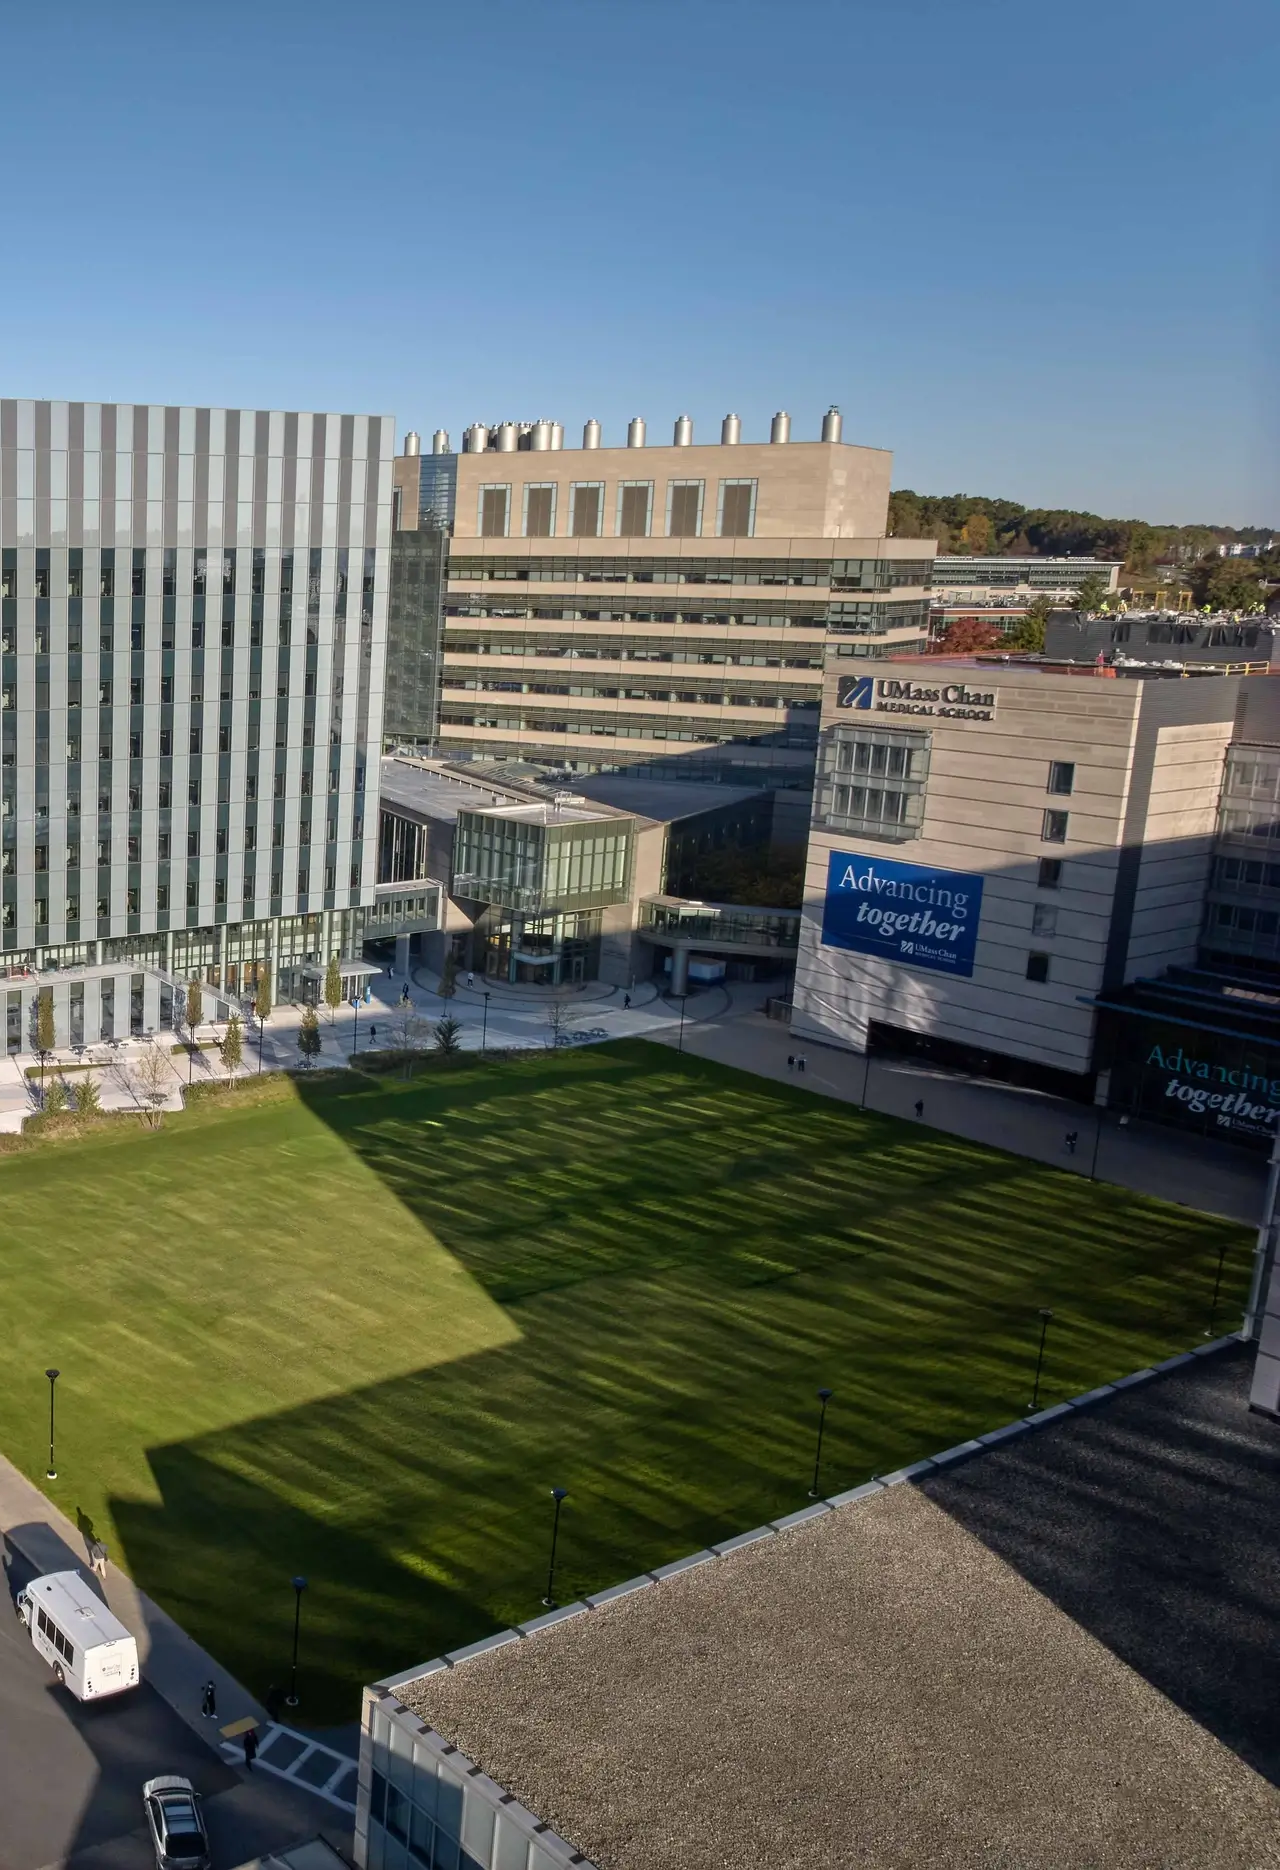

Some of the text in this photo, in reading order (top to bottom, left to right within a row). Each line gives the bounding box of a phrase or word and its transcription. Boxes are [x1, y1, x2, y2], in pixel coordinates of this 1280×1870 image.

[876, 701, 994, 721] MEDICAL SCHOOL
[877, 679, 995, 706] UMass Chan
[839, 864, 969, 919] Advancing
[856, 902, 966, 941] together
[1165, 1079, 1280, 1123] together
